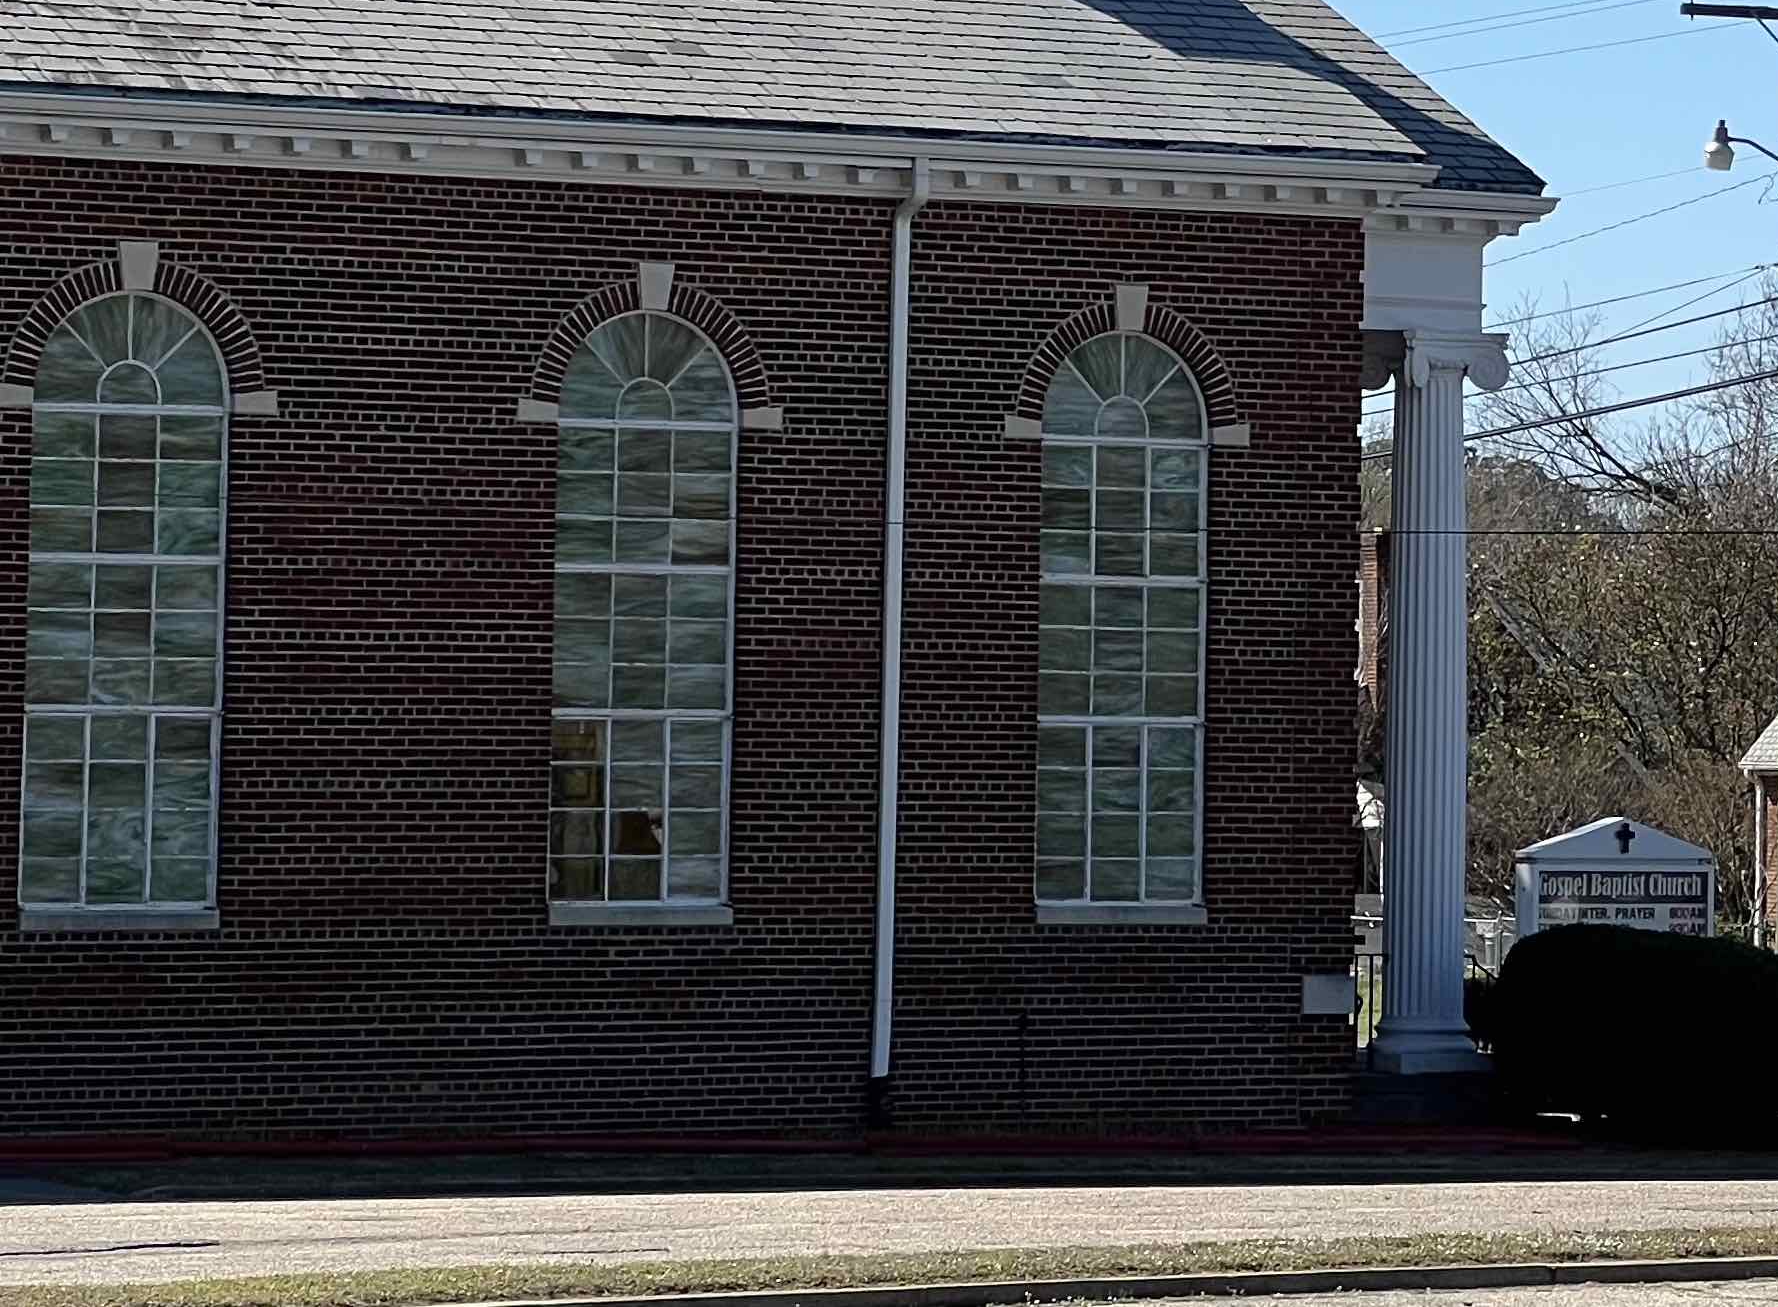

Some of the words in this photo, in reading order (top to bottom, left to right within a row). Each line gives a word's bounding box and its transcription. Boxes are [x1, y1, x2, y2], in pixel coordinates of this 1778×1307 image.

[1541, 873, 1588, 899] Gospel
[1590, 873, 1645, 899] Baptist
[1649, 873, 1701, 896] Church
[1615, 907, 1655, 919] PRAYER
